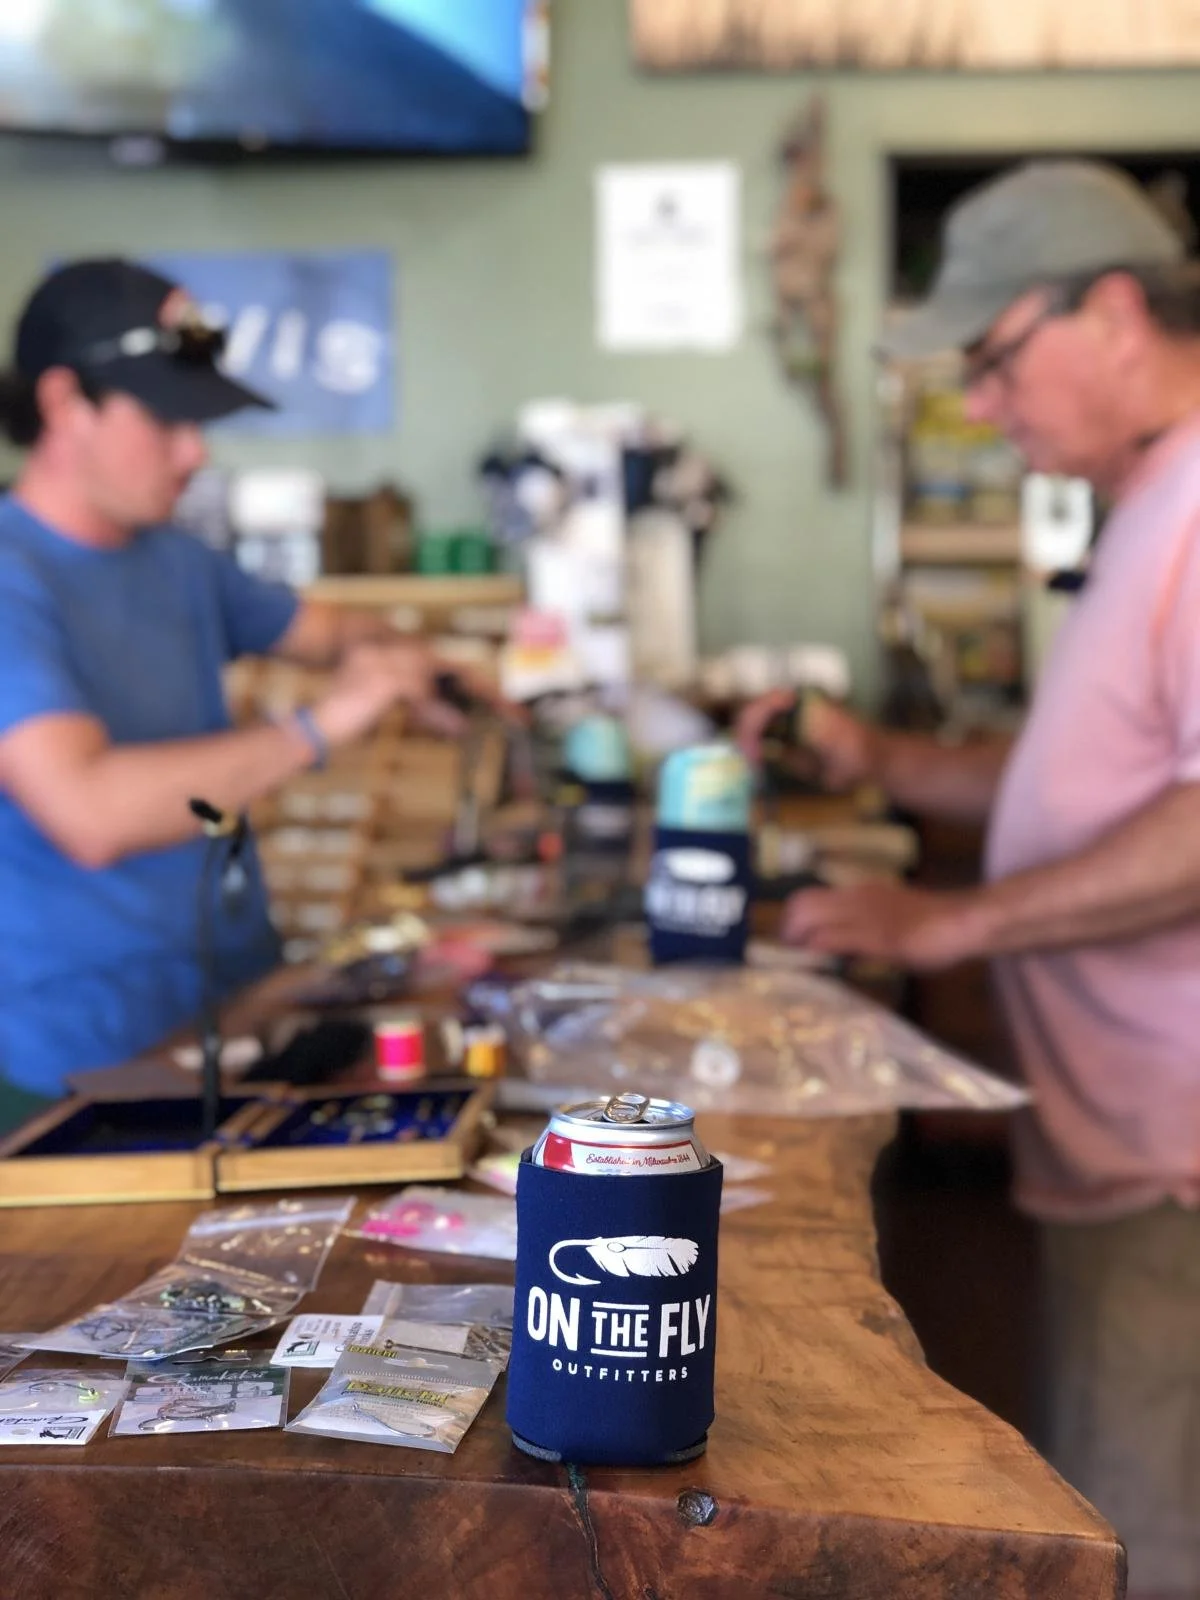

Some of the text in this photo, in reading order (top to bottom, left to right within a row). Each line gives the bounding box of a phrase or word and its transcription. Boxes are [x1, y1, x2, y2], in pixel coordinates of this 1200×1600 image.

[586, 1153, 631, 1165] Establishe
[632, 1157, 641, 1165] in
[527, 1286, 711, 1358] ON THE FLY
[552, 1358, 688, 1383] OUTFITTERS
